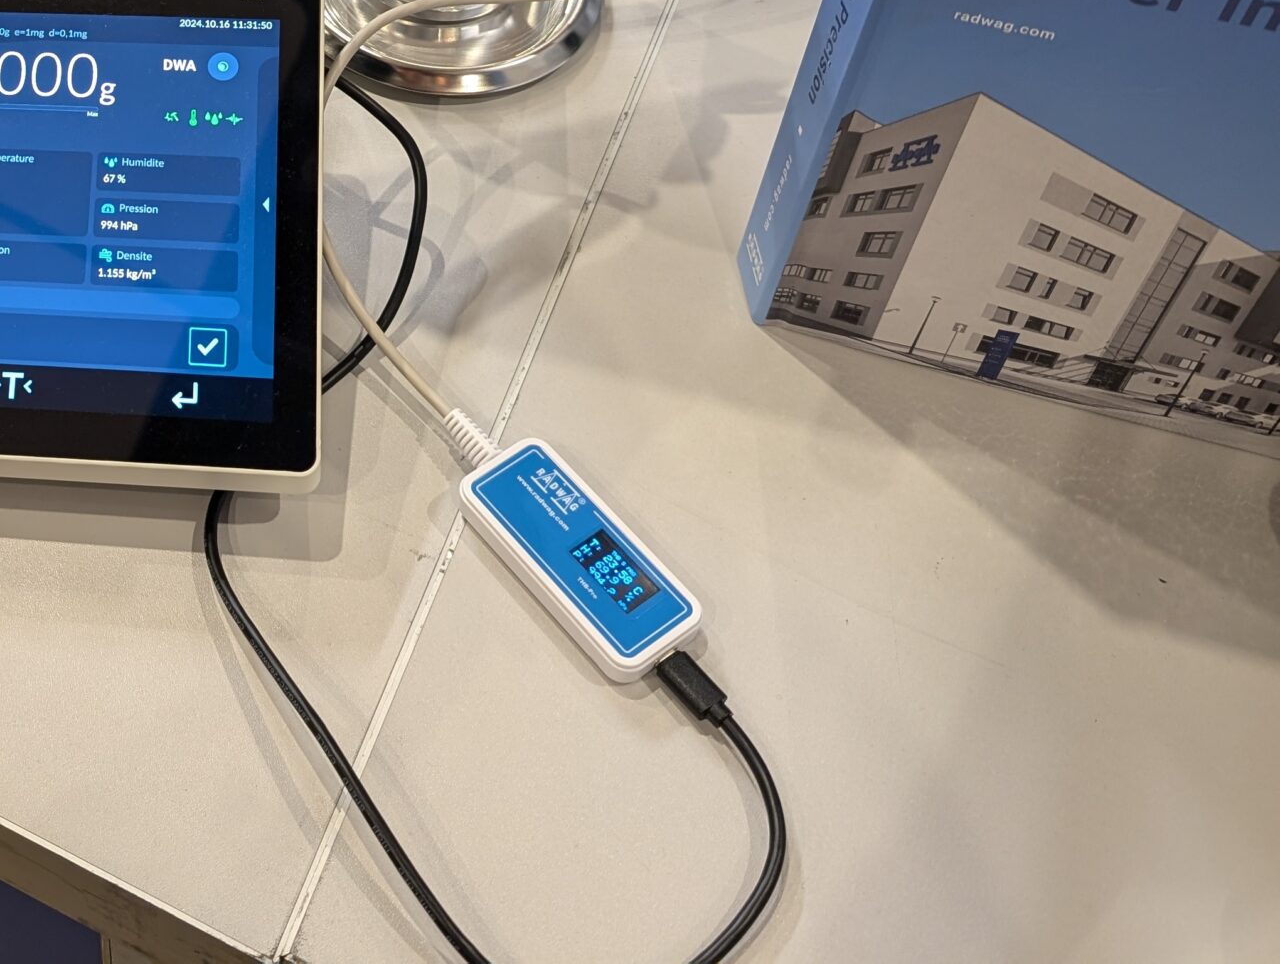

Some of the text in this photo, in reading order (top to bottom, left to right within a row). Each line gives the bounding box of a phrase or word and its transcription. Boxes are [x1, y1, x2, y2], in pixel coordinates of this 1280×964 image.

[179, 19, 273, 30] 2024.10.16 11:31:50
[954, 9, 1056, 41] radwag.com
[14, 28, 45, 38] e=1mg
[807, 0, 850, 105] Precision
[163, 59, 197, 72] DWA
[121, 157, 165, 169] Humidite
[102, 173, 126, 184] 67 %
[763, 154, 793, 232] radwag.com
[119, 203, 159, 215] Pression
[100, 220, 138, 232] 994 hPa
[116, 250, 153, 263] Densite
[97, 268, 125, 279] 1.155
[535, 467, 580, 513] RADWAG
[516, 474, 570, 532] www.radwag.com
[595, 560, 620, 585] 69.9
[602, 554, 633, 585] 23.58
